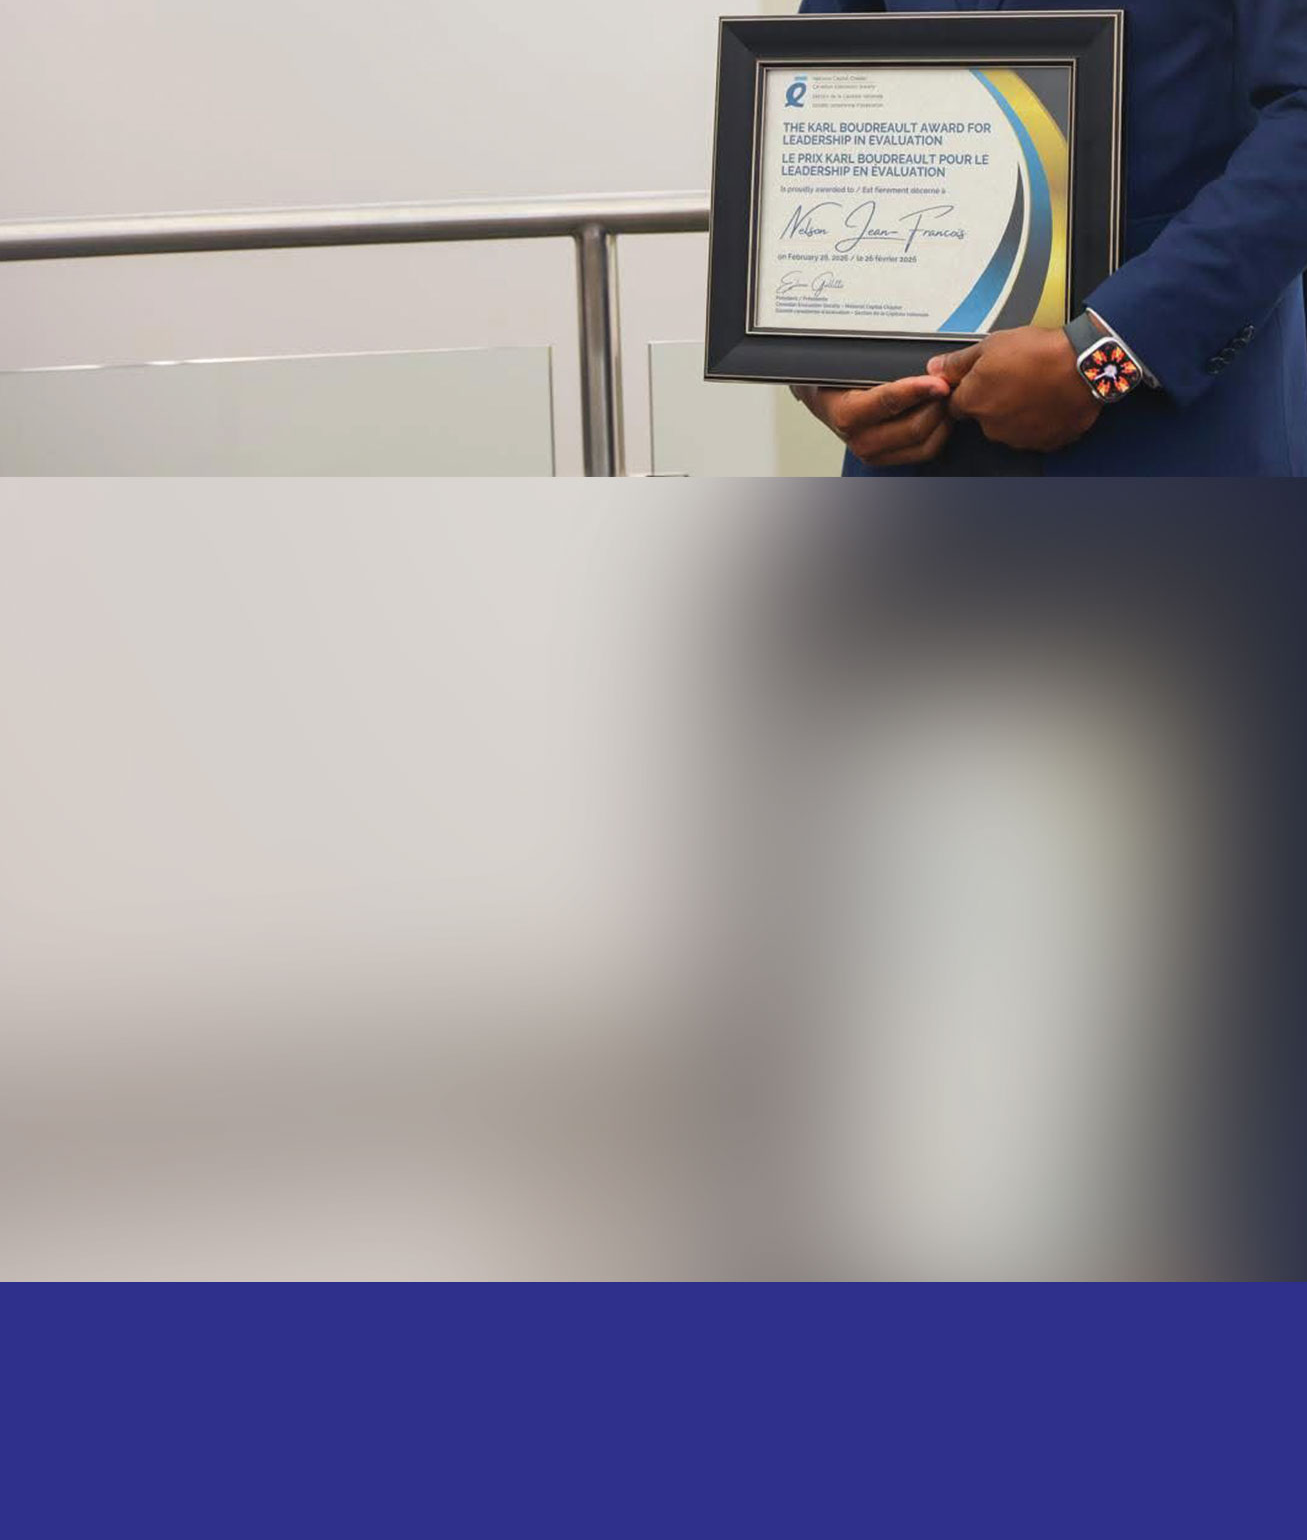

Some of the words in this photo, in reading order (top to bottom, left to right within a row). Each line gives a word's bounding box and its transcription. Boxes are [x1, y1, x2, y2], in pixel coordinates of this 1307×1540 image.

[783, 122, 804, 133] THE
[808, 122, 837, 133] KARL
[840, 122, 917, 134] BOUDREAULT
[920, 122, 964, 134] AWARD
[968, 123, 991, 134] FOR
[783, 135, 851, 145] LEADERSHIP
[854, 135, 866, 145] IN
[869, 135, 942, 146] EVALUATION
[782, 153, 795, 164] LE
[798, 154, 822, 164] PRIX
[826, 153, 854, 164] KARL
[857, 154, 936, 165] BOUDREAULT
[939, 154, 972, 165] POUR
[975, 155, 989, 165] LE
[781, 166, 851, 176] LEADERSHIP
[853, 166, 868, 177] EN
[871, 163, 945, 177] ÉVALUATION
[779, 201, 842, 240] Nelson
